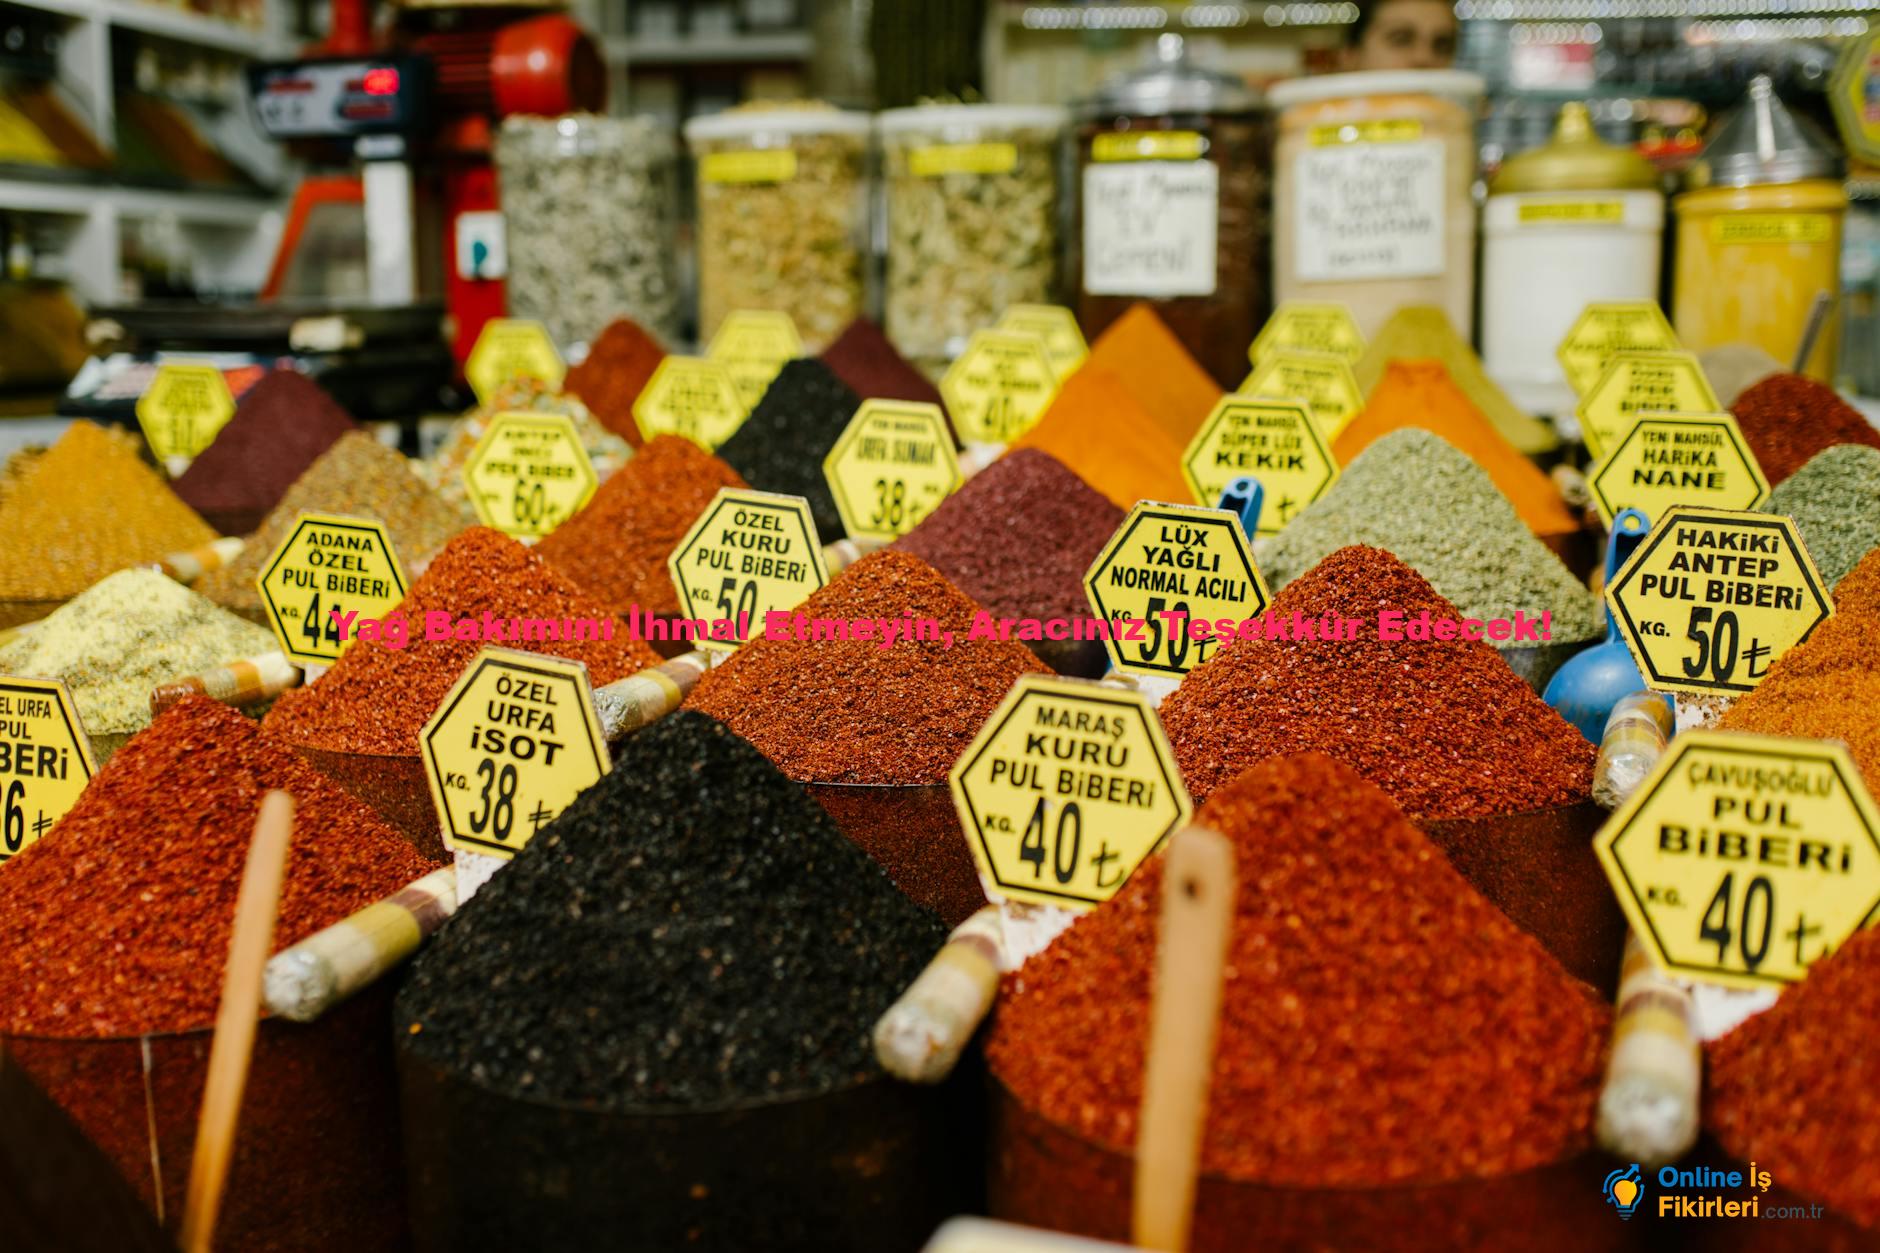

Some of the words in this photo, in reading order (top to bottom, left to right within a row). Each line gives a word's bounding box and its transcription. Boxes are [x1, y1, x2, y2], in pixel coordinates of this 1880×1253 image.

[1633, 469, 1726, 489] NANE
[514, 479, 545, 528] 60
[734, 508, 785, 532] ÖZEL
[872, 479, 906, 528] 38
[307, 532, 374, 552] ADANA
[721, 529, 791, 555] KURU
[1160, 524, 1209, 548] LÜX
[308, 549, 370, 573] ÖZEL
[697, 548, 733, 571] PUL
[1142, 544, 1221, 573] YAĞLI
[1668, 551, 1779, 579] ANTEP
[283, 569, 319, 589] PUL
[1111, 566, 1189, 595] NORMAL
[1194, 576, 1247, 603] ACILI
[1640, 574, 1696, 601] PUL
[714, 577, 758, 639] 50
[1139, 597, 1191, 668] 50
[1639, 621, 1671, 637] KG.
[1682, 606, 1739, 682] 50
[496, 672, 558, 706] ÖZEL
[18, 698, 51, 719] URFA
[487, 700, 555, 734] URFA
[1036, 706, 1126, 741] MARAŞ
[0, 720, 32, 740] PUL
[1026, 733, 1128, 768] KURU
[990, 759, 1044, 790] PUL
[1688, 761, 1834, 798] ÇAVUŞOĞLU
[445, 772, 471, 792] KG.
[469, 758, 518, 841] 38
[1713, 796, 1803, 829] PUL
[1019, 797, 1081, 884] 40
[1700, 871, 1774, 974] 40
